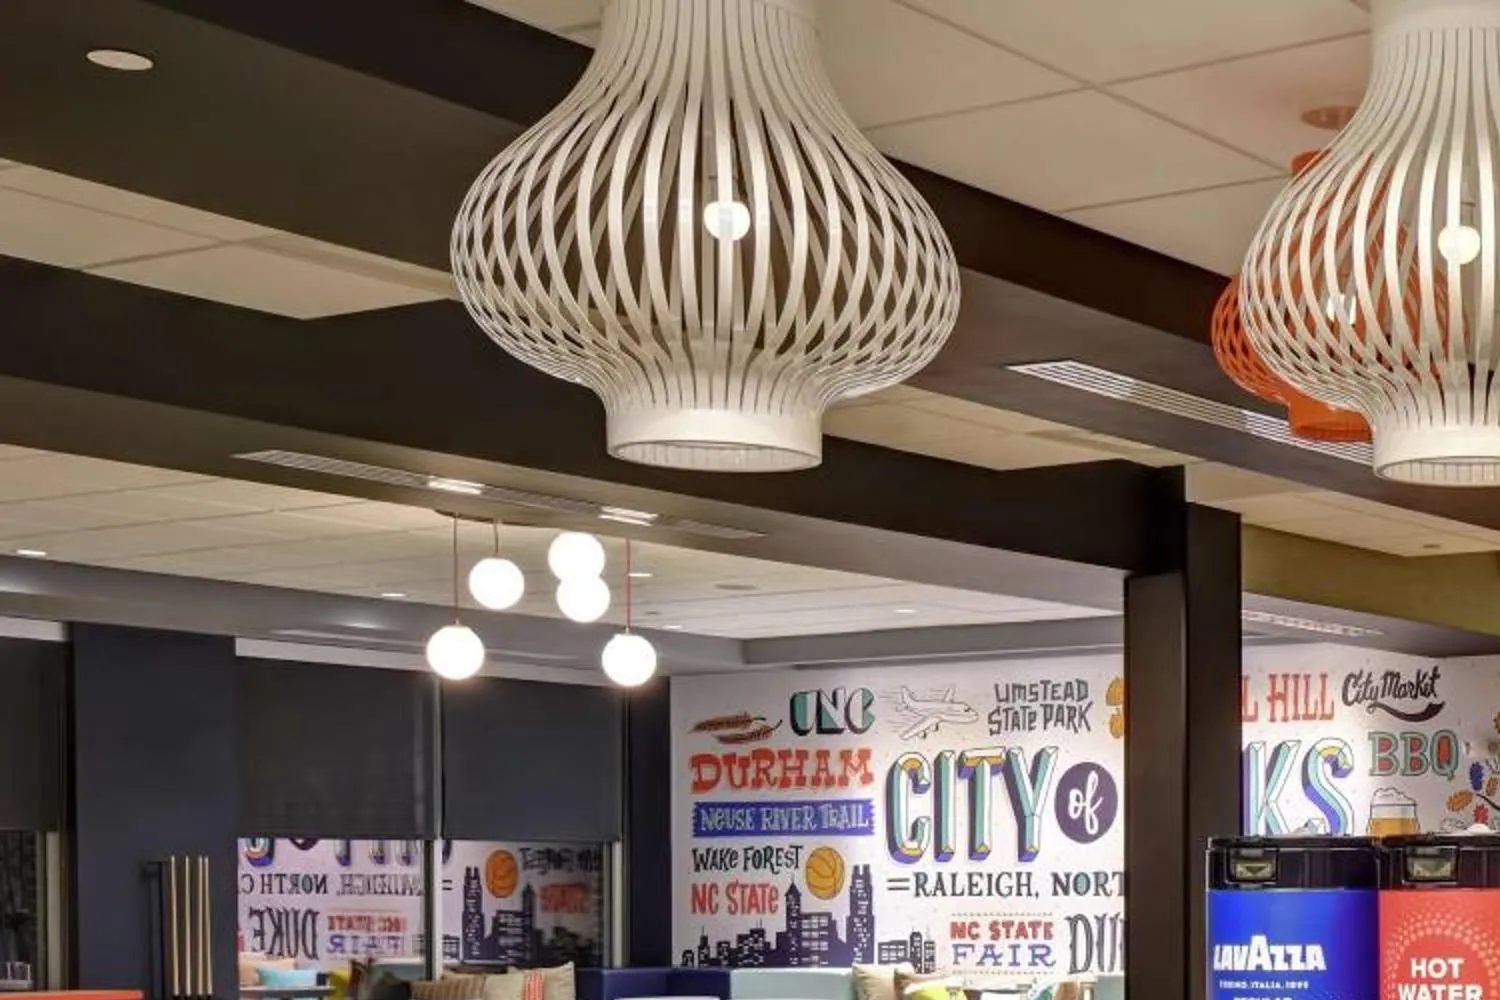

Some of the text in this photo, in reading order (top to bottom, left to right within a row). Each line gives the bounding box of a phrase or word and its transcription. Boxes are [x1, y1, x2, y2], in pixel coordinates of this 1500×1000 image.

[1266, 673, 1335, 722] HILL
[1341, 665, 1441, 706] City Market
[789, 686, 876, 737] UNC
[1039, 701, 1094, 735] PARK
[688, 746, 875, 795] DURHAM
[1368, 729, 1459, 781] BBQ
[760, 805, 818, 831] RIVER
[820, 803, 869, 829] TRAIL
[885, 745, 1104, 865] CITY of
[743, 845, 804, 875] FOREST
[690, 882, 719, 916] NC
[912, 871, 1040, 899] RALEIGH,
[950, 920, 1055, 941] NC STATE
[1064, 912, 1125, 976] DU
[951, 943, 1057, 968] FAIR
[1213, 935, 1328, 971] LAVAZZA
[1411, 957, 1466, 979] HOT
